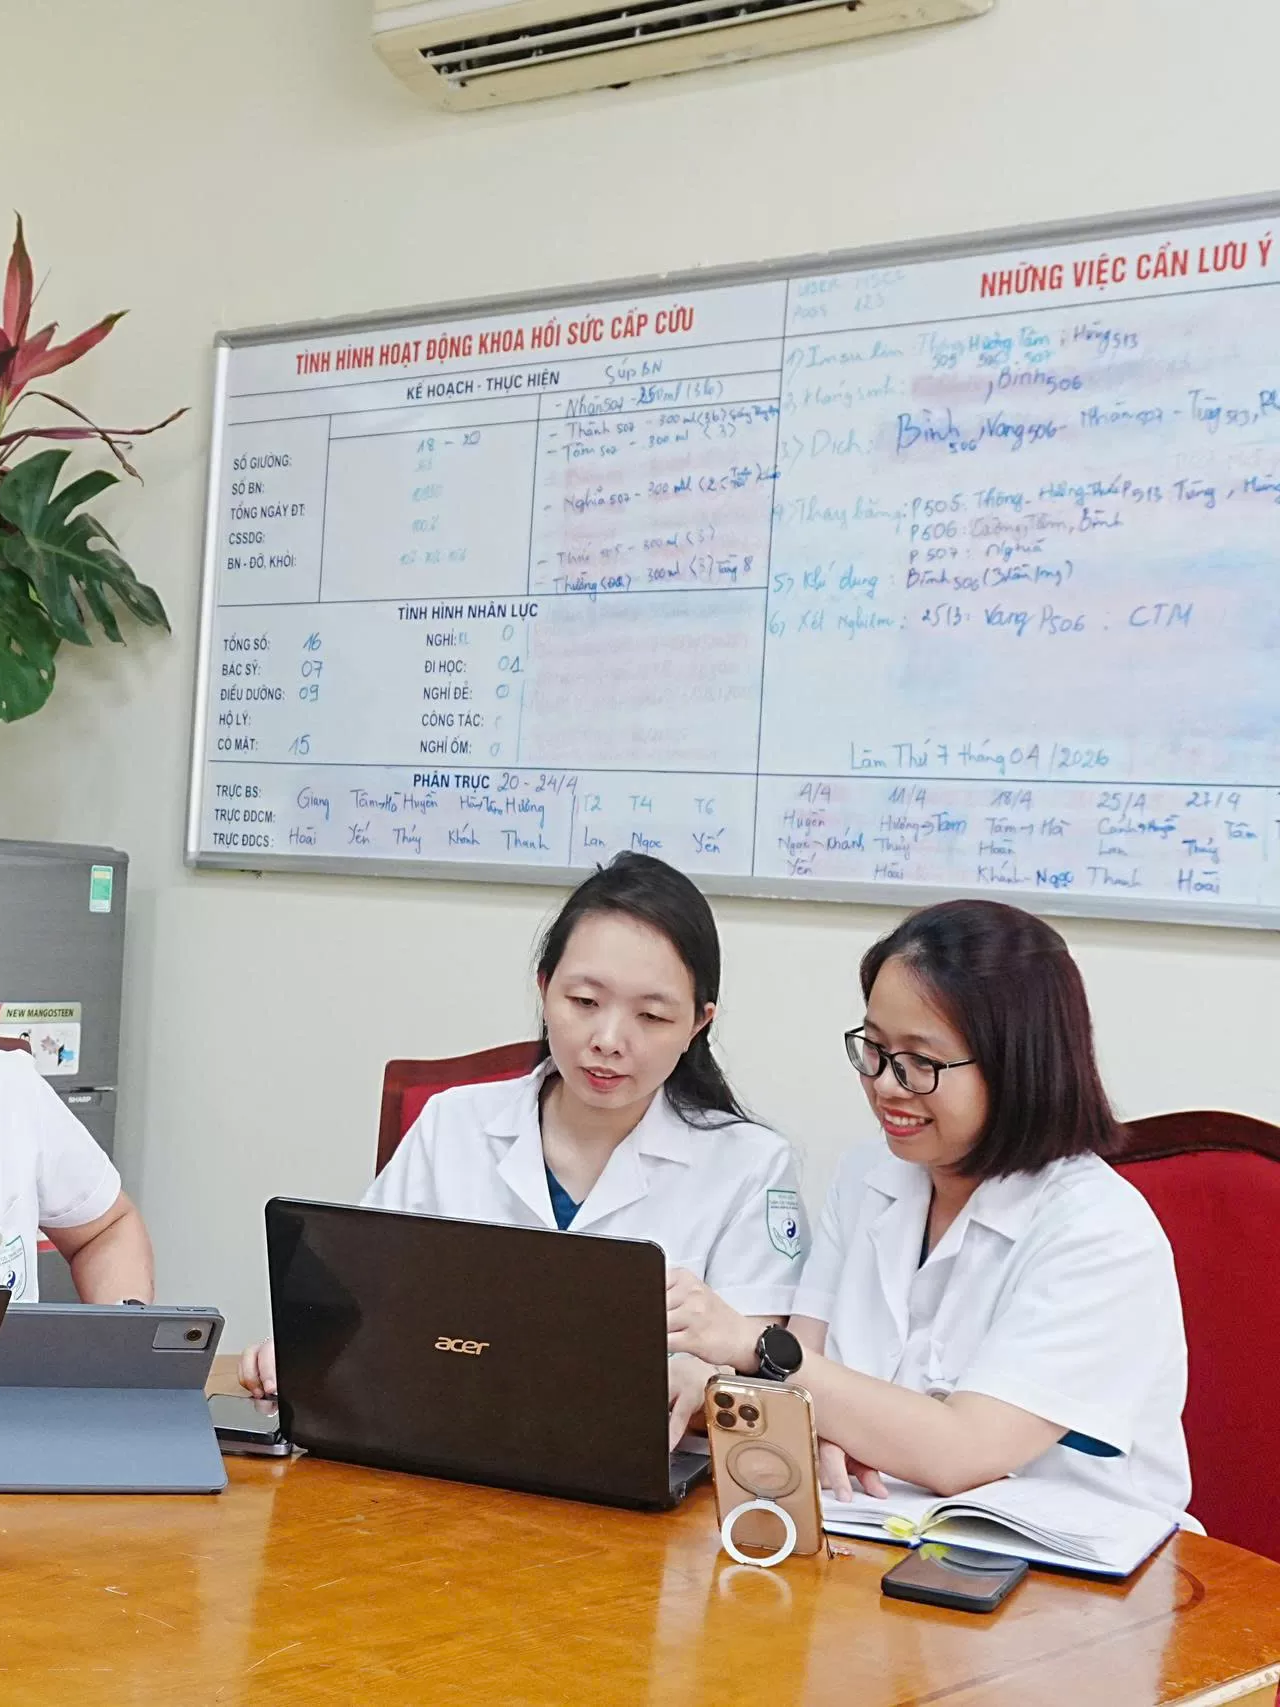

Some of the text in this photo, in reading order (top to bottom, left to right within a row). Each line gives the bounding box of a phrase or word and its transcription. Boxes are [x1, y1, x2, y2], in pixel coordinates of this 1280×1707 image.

[980, 261, 1064, 298] NHỮNG
[1073, 252, 1126, 291] VIỆC
[1198, 240, 1248, 273] LƯU
[1257, 231, 1273, 268] Ý
[296, 350, 331, 375] TÌNH
[335, 344, 375, 371] HÌNH
[379, 340, 423, 368] HOẠT
[426, 332, 472, 364] ĐỘNG
[478, 328, 525, 355] KHOA
[567, 313, 605, 345] SỨC
[611, 307, 649, 339] CẤP
[655, 303, 695, 334] CỨU
[407, 368, 560, 400] KẾ HOẠCH THỰC HIỆN
[233, 452, 292, 471] SỐ GIƯỜNG:
[231, 479, 265, 495] SỐ BN:
[231, 502, 258, 520] TỔNG
[260, 502, 288, 519] NGÀY
[228, 532, 265, 545] CSSDG:
[227, 556, 241, 570] BN
[398, 601, 539, 621] TÌNH HÌNH NHÂN LỰC
[1128, 602, 1194, 629] CTM
[223, 632, 251, 651] TỔNG
[301, 660, 323, 678] 07
[424, 659, 466, 676] ĐI HỌC:
[299, 684, 320, 702] 09
[219, 710, 234, 728] HỘ
[421, 710, 484, 727] CÔNG TÁC:
[288, 734, 311, 756] 15
[413, 770, 490, 793] PHÂN TRỰC
[496, 772, 520, 792] 20
[216, 784, 261, 800] TRỰC BS:
[214, 808, 276, 825] TRỰC ĐDCM:
[212, 832, 239, 849] TRỰC
[6, 1009, 26, 1018] NEW
[26, 1008, 75, 1018] MANGOSTEEN
[434, 1336, 490, 1355] acer
